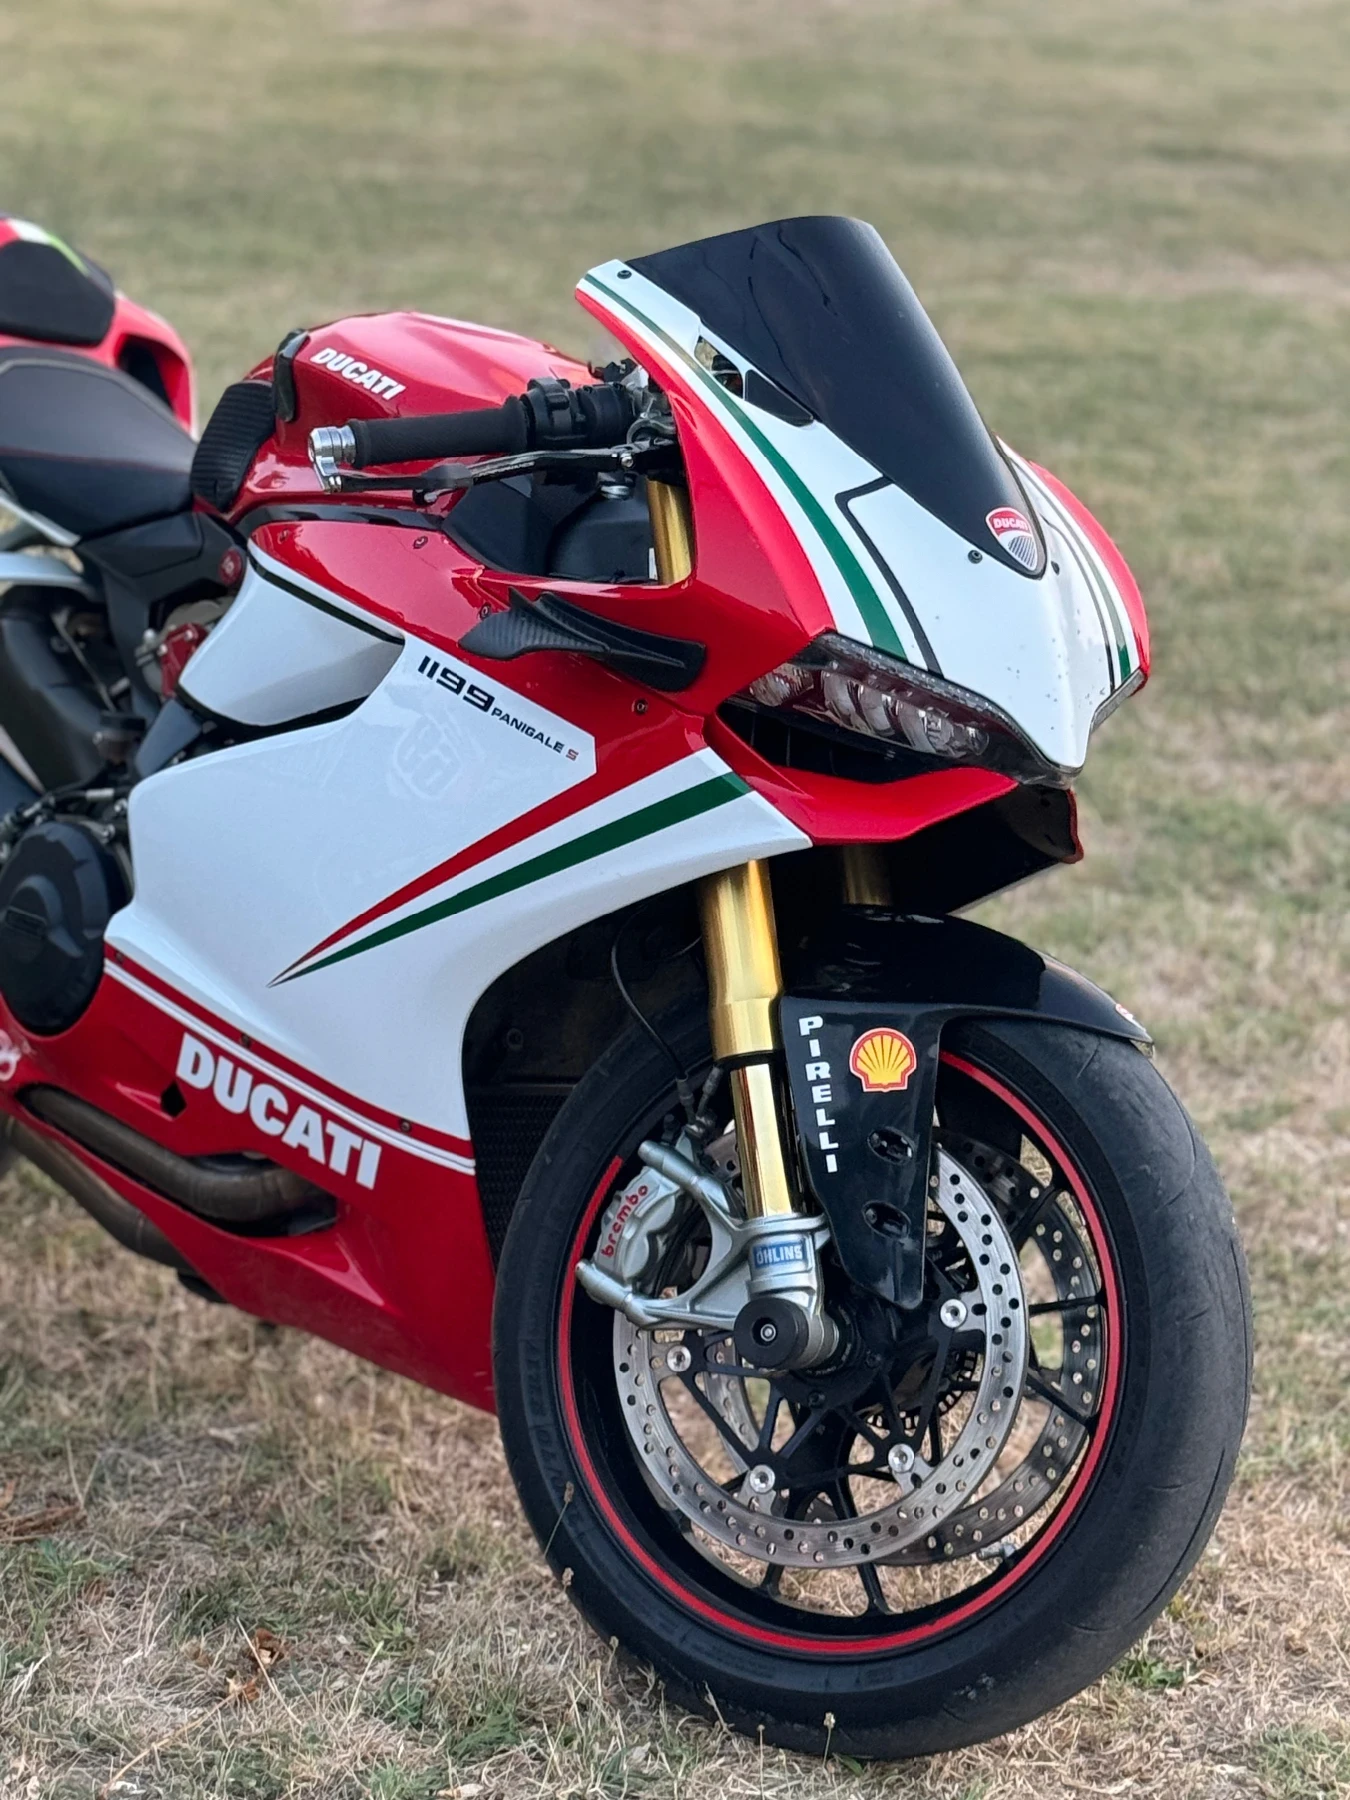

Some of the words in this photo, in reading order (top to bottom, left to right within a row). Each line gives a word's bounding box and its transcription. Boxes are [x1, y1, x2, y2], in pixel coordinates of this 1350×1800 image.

[310, 347, 406, 401] DUCATI
[992, 517, 1029, 531] DUCATI
[417, 655, 496, 713] 1199
[491, 707, 565, 754] PANIGALE
[565, 748, 579, 761] S
[176, 1033, 383, 1190] DUCATI
[799, 1015, 838, 1173] PIRELLI
[601, 1184, 648, 1258] brembo
